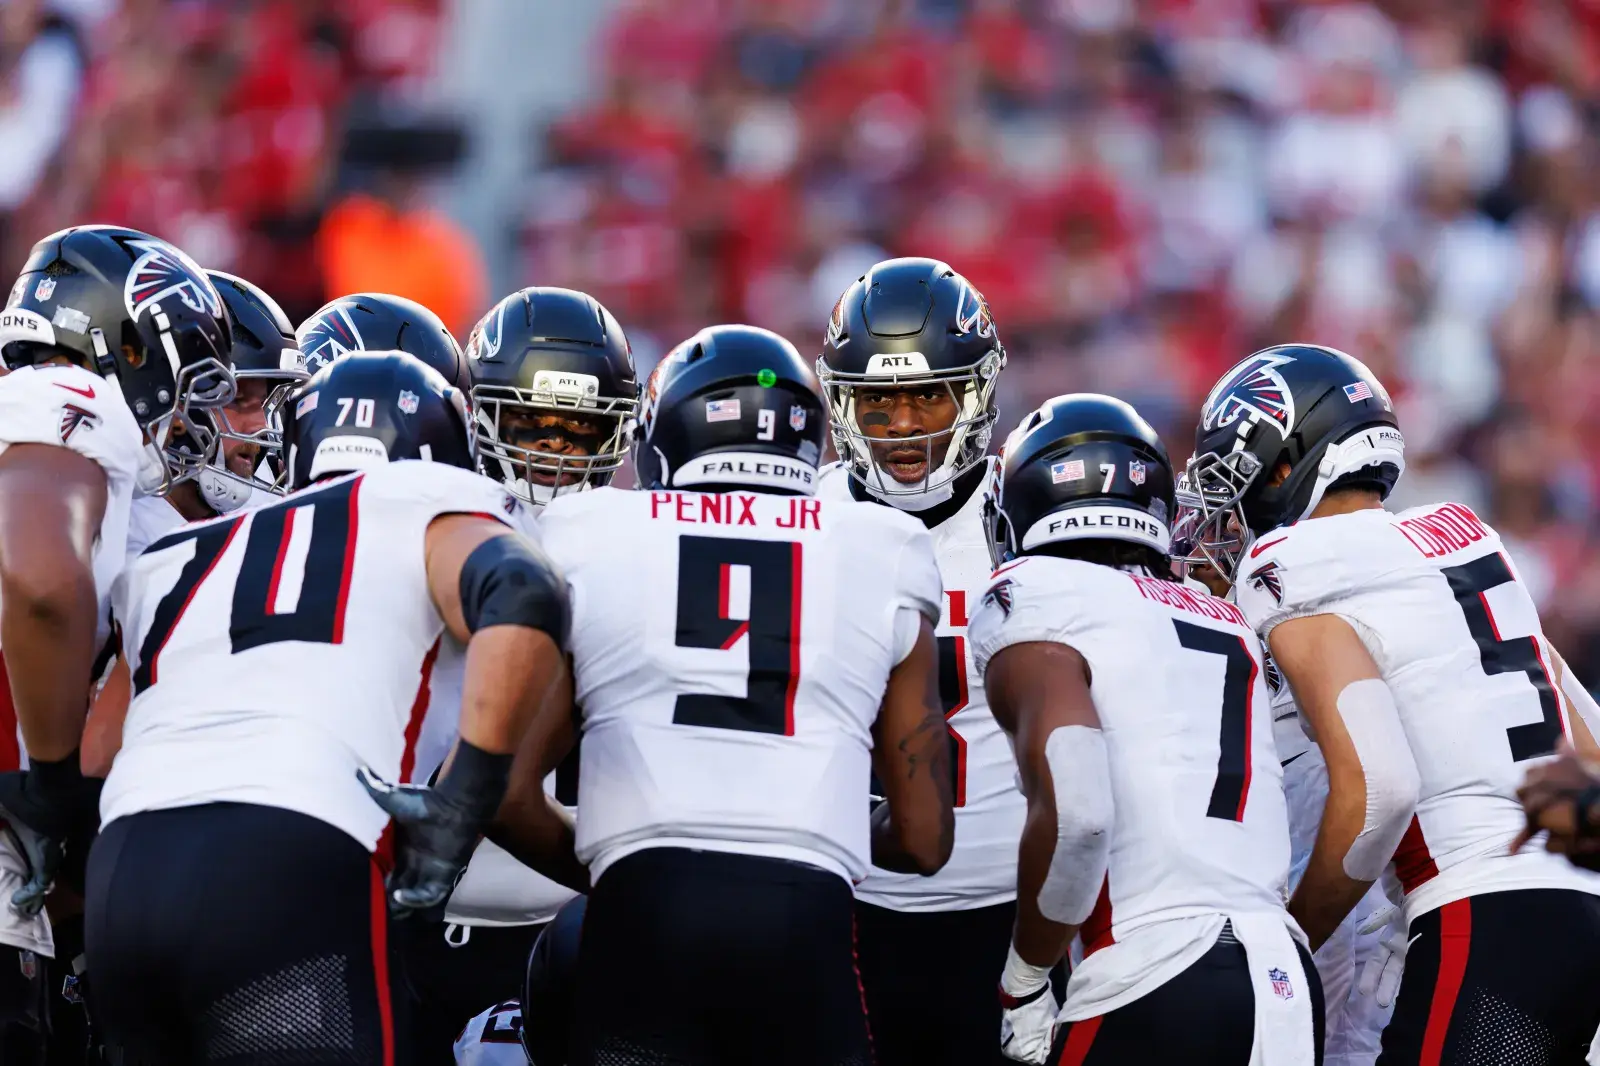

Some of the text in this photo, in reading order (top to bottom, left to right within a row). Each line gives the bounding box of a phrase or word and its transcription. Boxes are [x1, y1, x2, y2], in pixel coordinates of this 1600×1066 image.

[0, 315, 38, 331] ONS
[881, 356, 912, 367] ATL
[558, 378, 579, 387] ATL
[335, 397, 375, 428] 70
[757, 409, 776, 441] 9
[320, 444, 383, 457] FALCONS
[702, 461, 812, 484] FALCONS
[1099, 463, 1116, 494] 7
[651, 492, 822, 530] PENIX JR
[1048, 514, 1159, 538] FALCONS
[1390, 502, 1489, 559] LONDON
[134, 473, 366, 699] 70
[672, 534, 803, 737] 9
[1440, 551, 1567, 763] 5
[1171, 617, 1259, 823] 7
